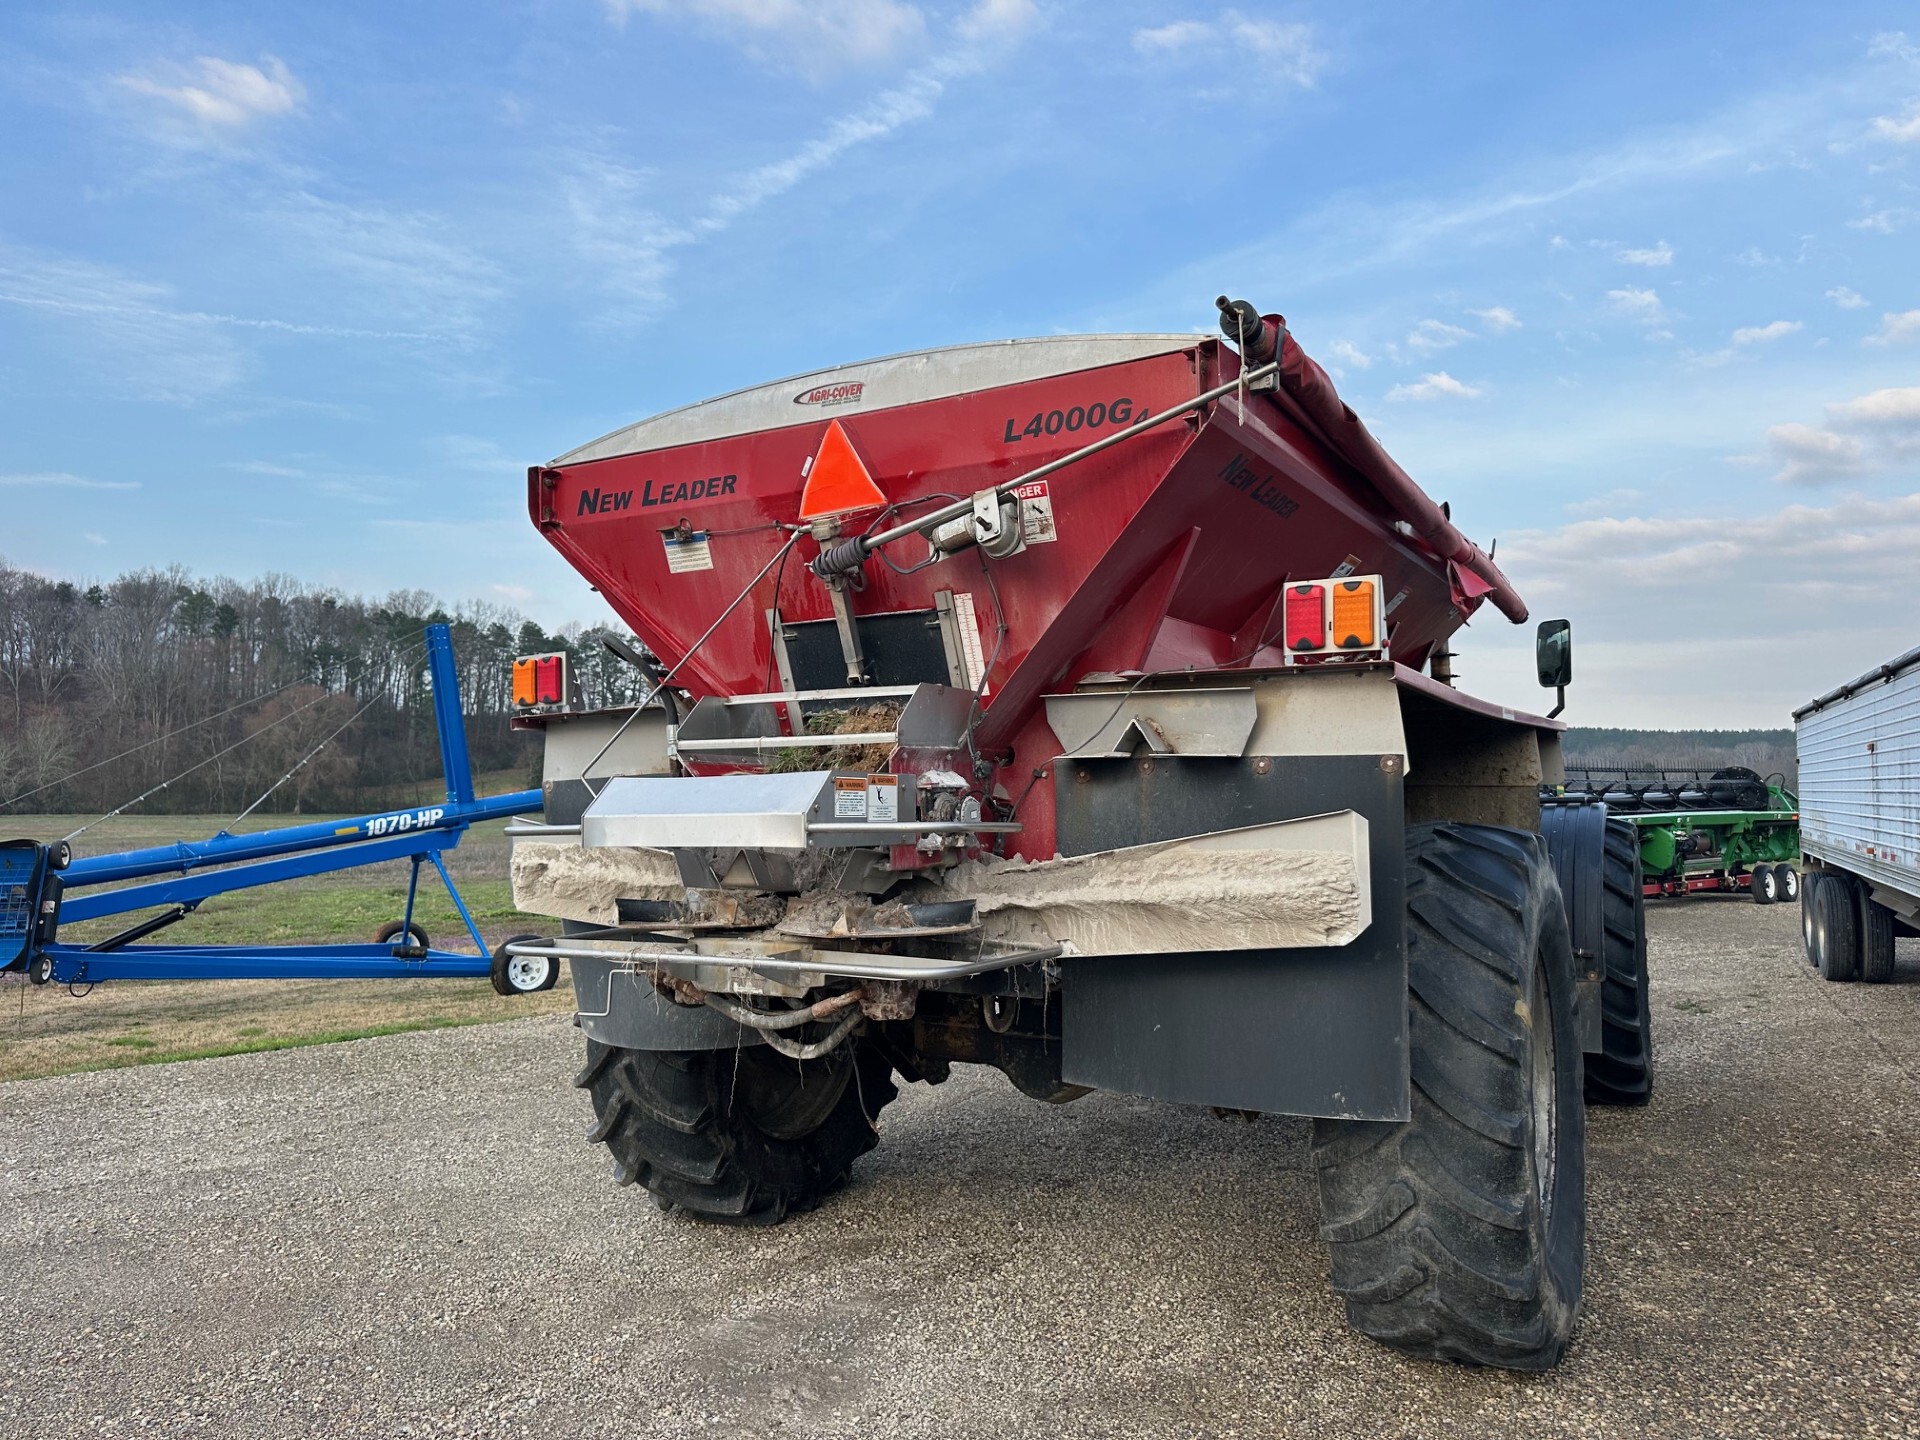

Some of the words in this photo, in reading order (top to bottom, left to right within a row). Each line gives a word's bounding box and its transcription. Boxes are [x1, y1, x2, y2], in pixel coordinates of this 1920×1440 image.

[807, 383, 863, 403] AGRI-COVER
[1010, 485, 1043, 498] NGER
[366, 808, 444, 837] 1070-HP
